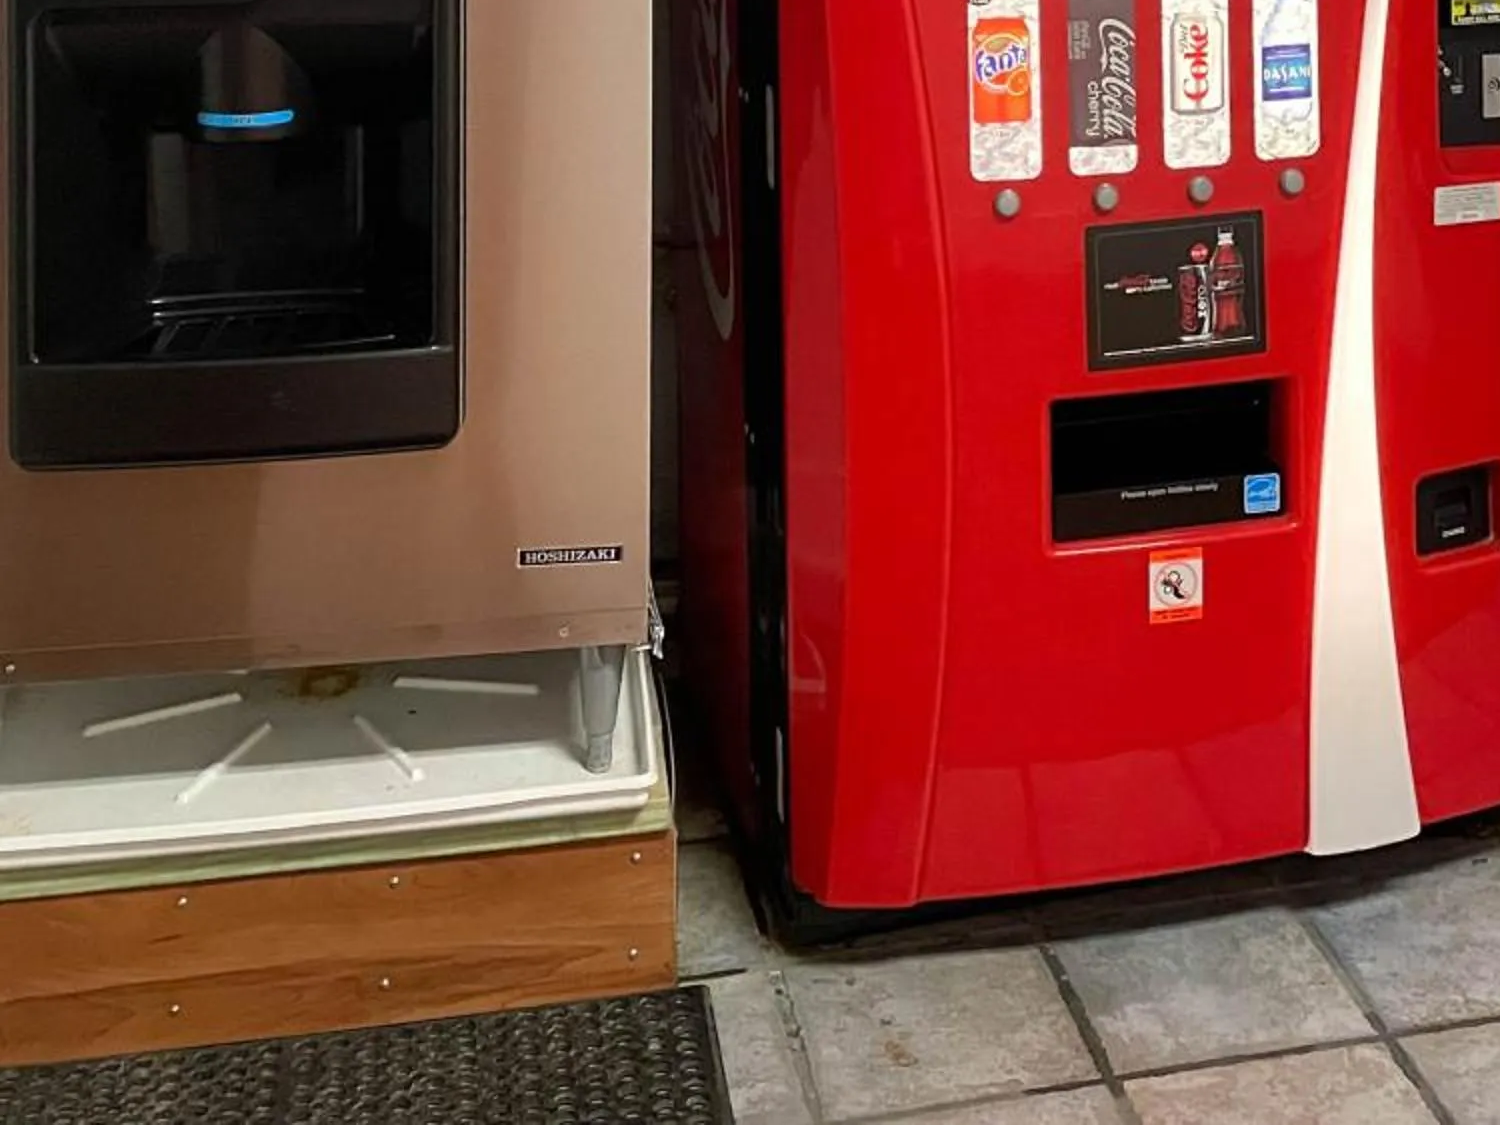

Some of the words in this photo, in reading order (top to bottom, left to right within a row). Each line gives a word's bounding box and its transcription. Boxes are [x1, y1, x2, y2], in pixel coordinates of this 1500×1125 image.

[1098, 18, 1137, 139] Coca-Cola
[1182, 24, 1209, 102] Coke
[1263, 63, 1312, 83] DASANI
[1085, 80, 1101, 136] cherry
[525, 548, 617, 564] HOSHIZAKI
